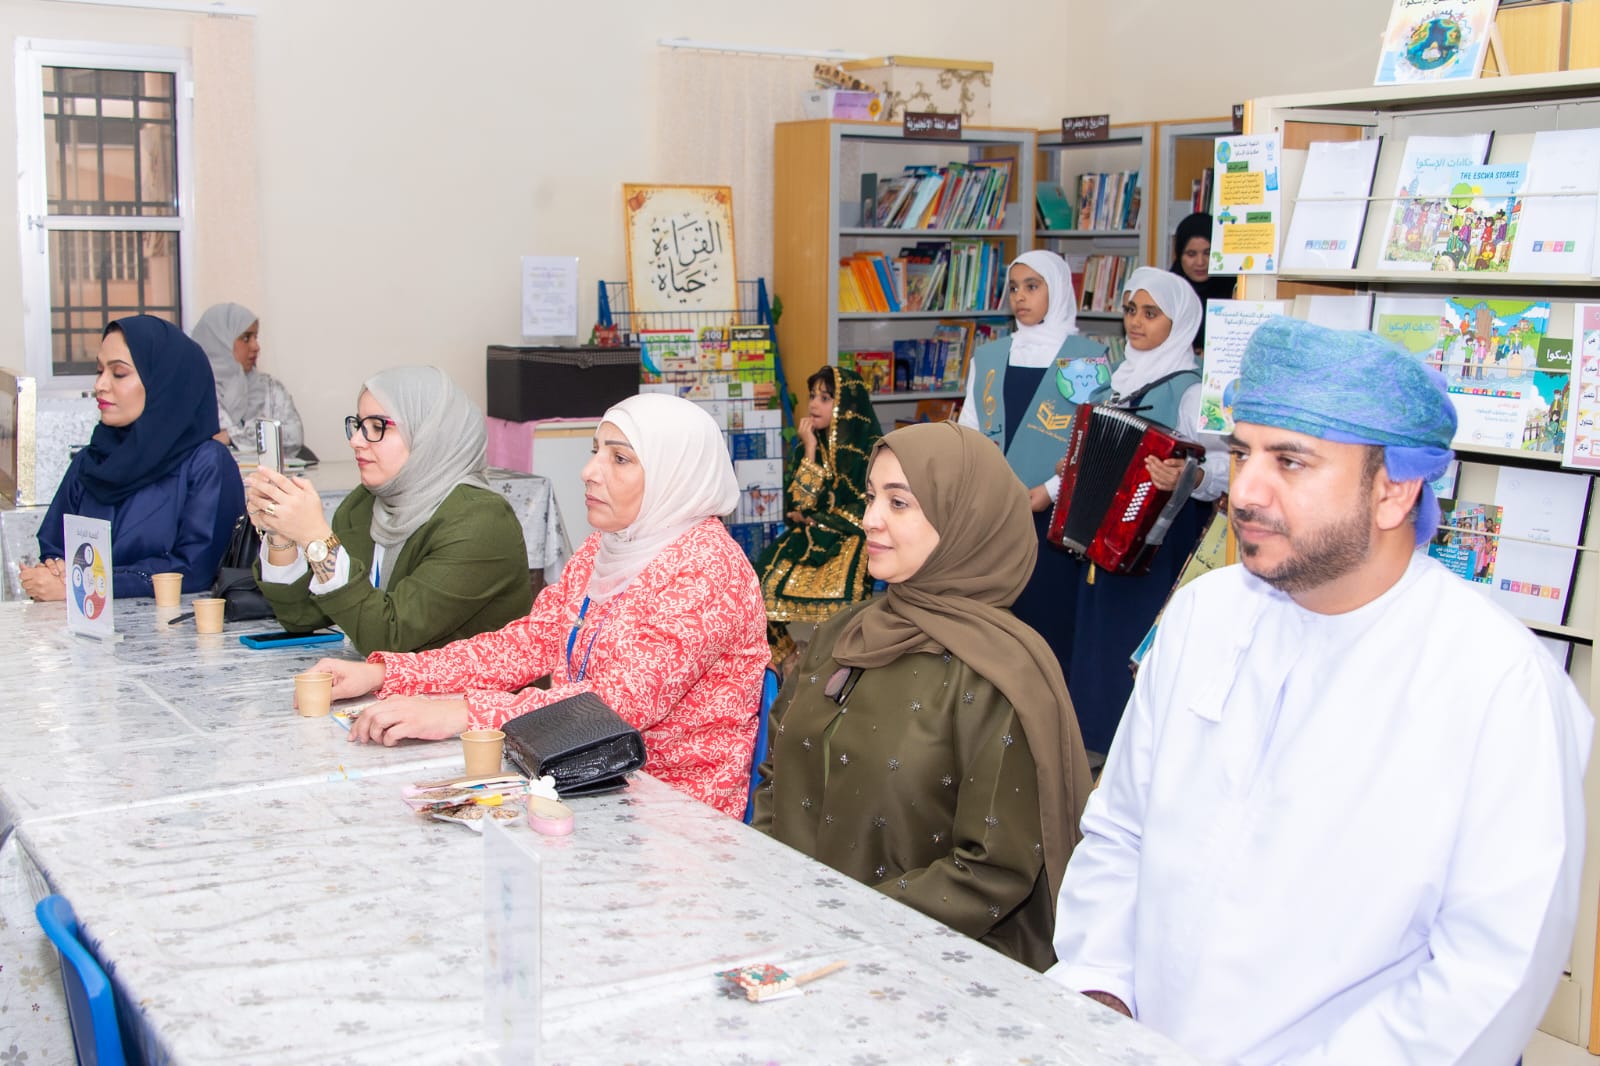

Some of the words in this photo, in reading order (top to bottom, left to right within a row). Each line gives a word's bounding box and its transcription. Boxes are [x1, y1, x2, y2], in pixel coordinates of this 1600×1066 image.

[947, 119, 959, 130] قسم
[1460, 171, 1471, 180] THE
[1473, 171, 1493, 180] ESCWA
[1496, 170, 1520, 179] STORIES
